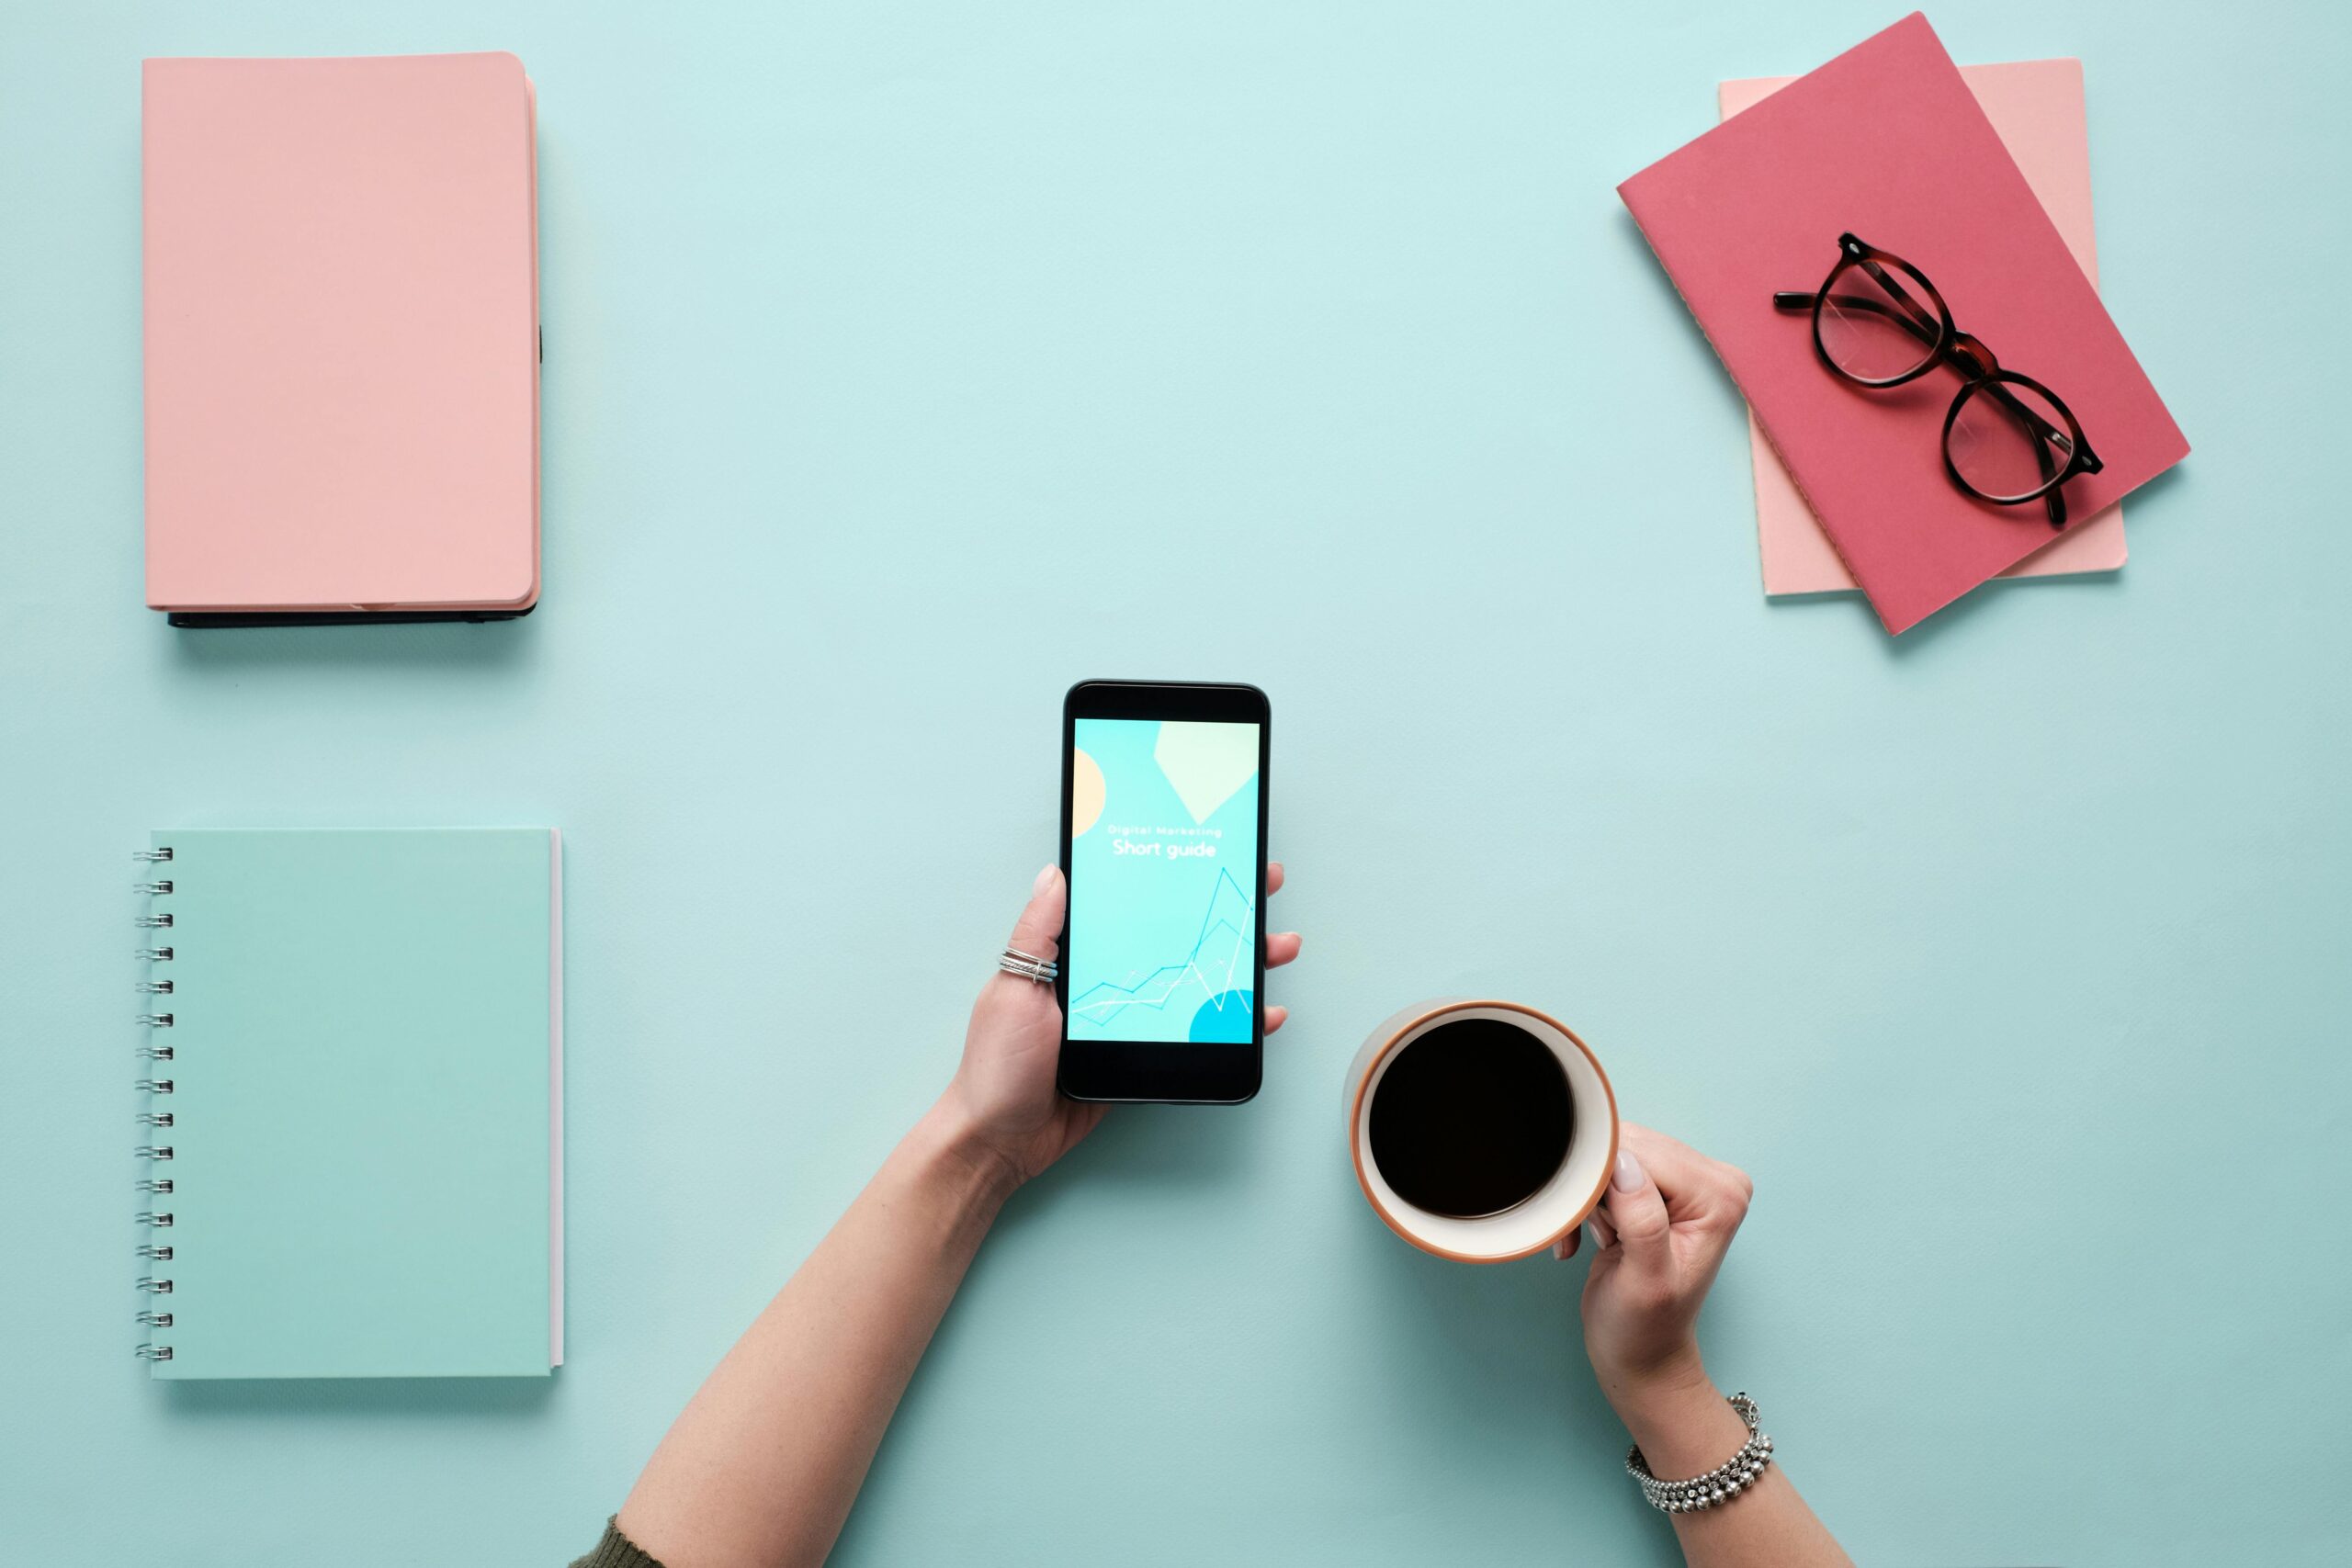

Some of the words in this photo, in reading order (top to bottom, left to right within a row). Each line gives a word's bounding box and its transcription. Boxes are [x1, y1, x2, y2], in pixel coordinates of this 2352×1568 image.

[1108, 825, 1151, 836] Digital
[1157, 827, 1222, 838] Marketing
[1113, 839, 1161, 855] Short
[1167, 841, 1216, 860] guide
